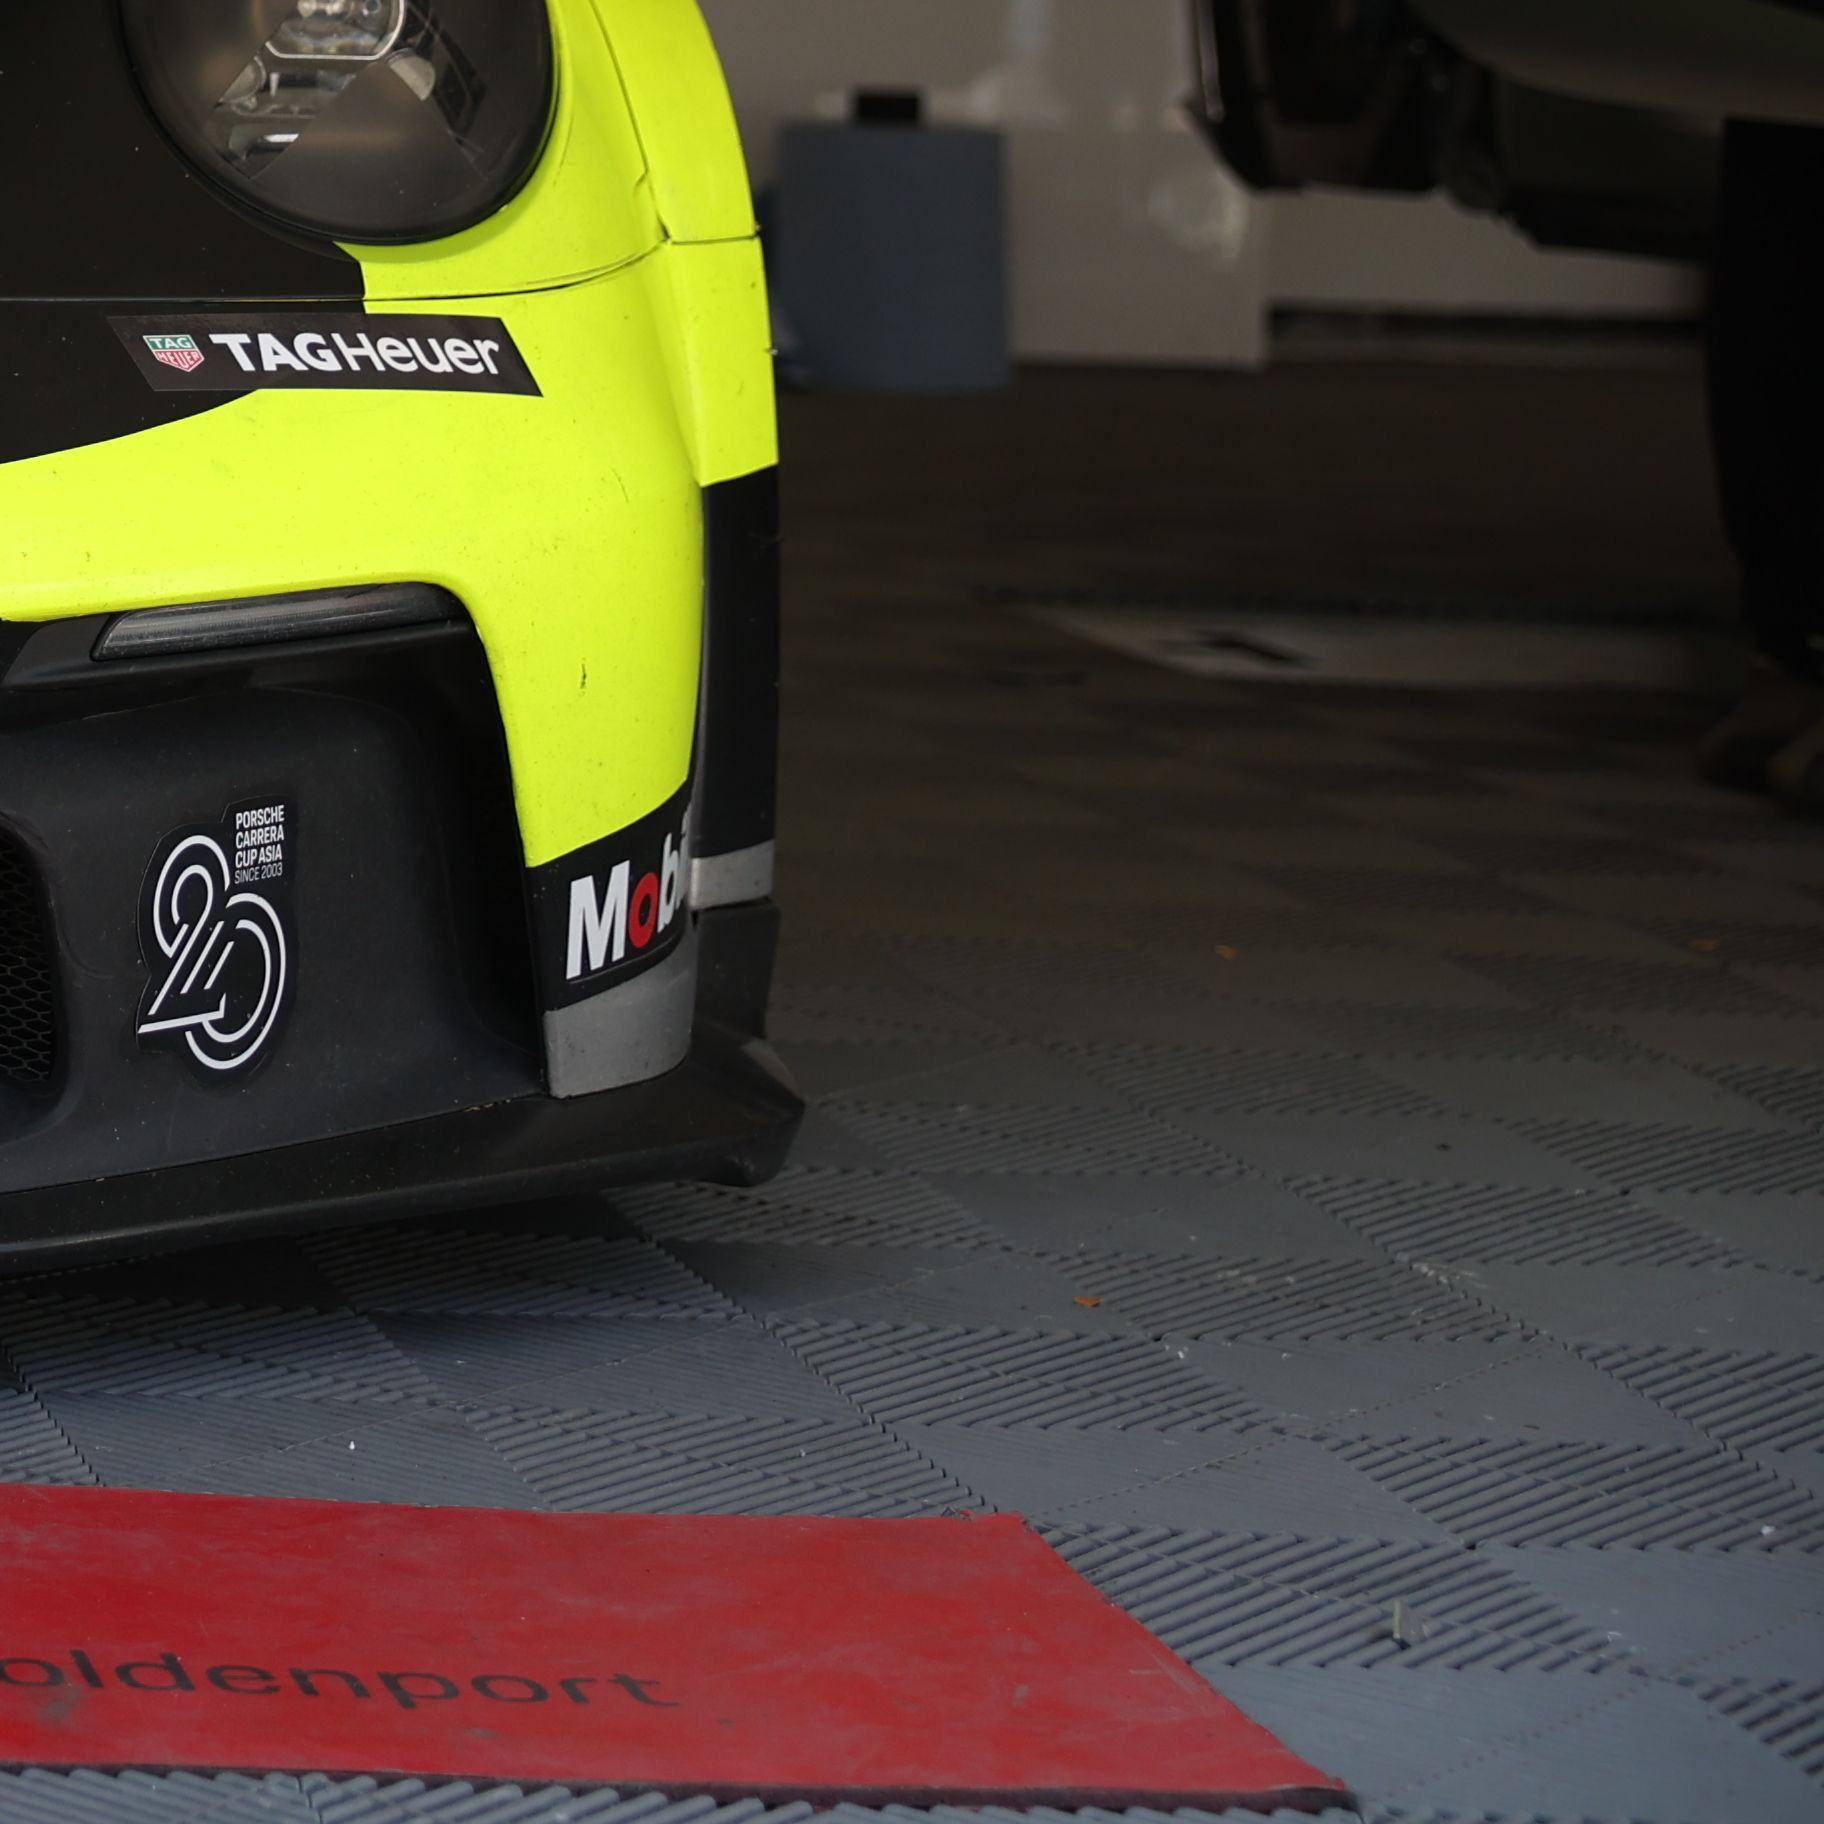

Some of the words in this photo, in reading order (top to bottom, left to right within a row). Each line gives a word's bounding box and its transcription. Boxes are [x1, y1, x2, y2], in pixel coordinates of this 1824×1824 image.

[149, 337, 191, 349] TAG
[156, 351, 200, 369] HEUER
[235, 804, 285, 830] PORSCHE
[235, 824, 285, 849] CARRERA
[235, 848, 258, 869] CUP
[258, 843, 283, 865] ASIA
[234, 865, 260, 885] SINCE
[261, 861, 283, 879] 2003
